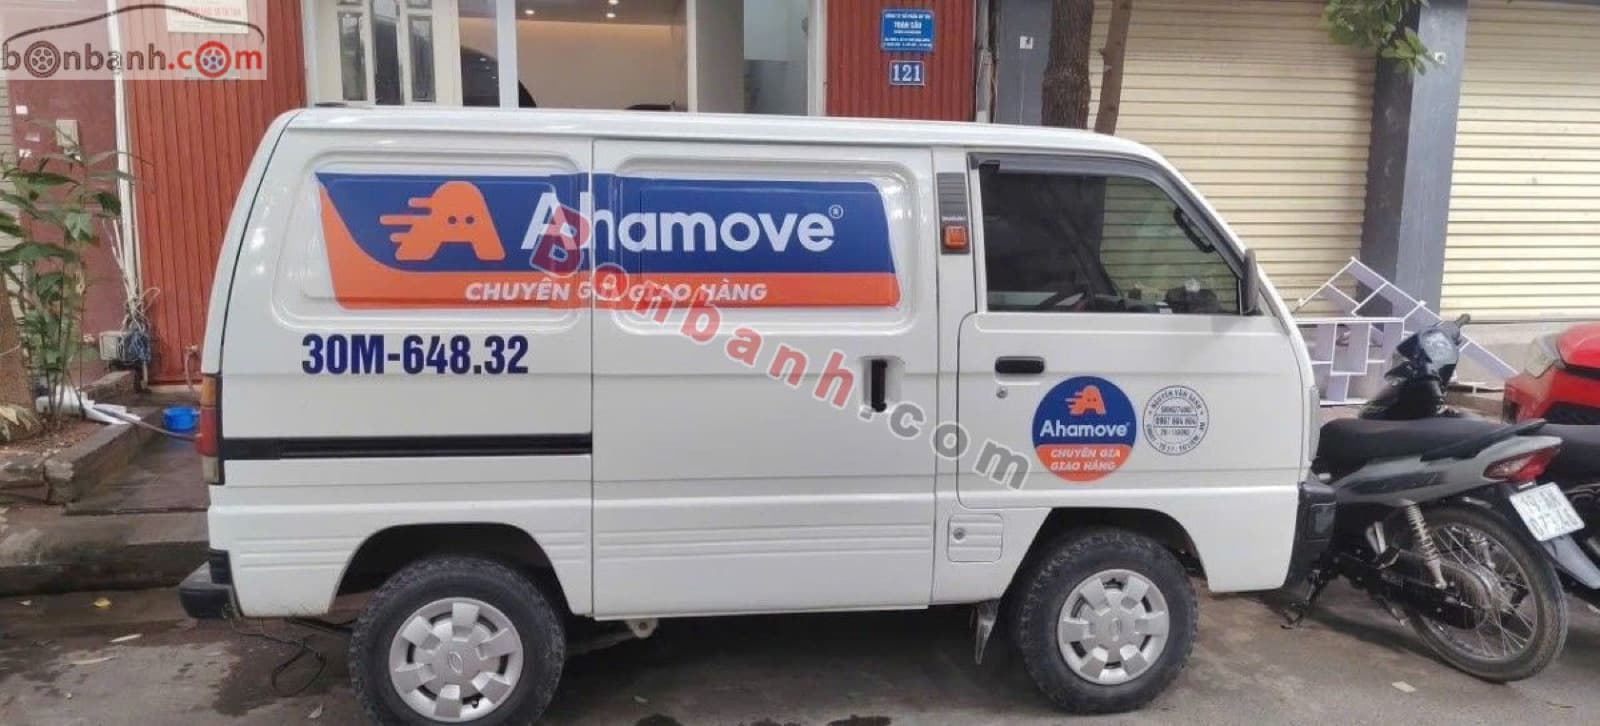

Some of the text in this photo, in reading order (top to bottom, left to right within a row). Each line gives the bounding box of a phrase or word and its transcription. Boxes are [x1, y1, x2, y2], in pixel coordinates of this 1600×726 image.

[893, 64, 921, 82] 121
[521, 192, 836, 252] Ahamove
[465, 277, 570, 301] CHUYÊN
[699, 278, 768, 301] HÀNG
[302, 333, 528, 375] 30M-648.32
[1040, 420, 1128, 437] Ahamove
[1050, 447, 1121, 458] CHUYÊN GIA
[1050, 459, 1116, 471] GIAO HÀNG
